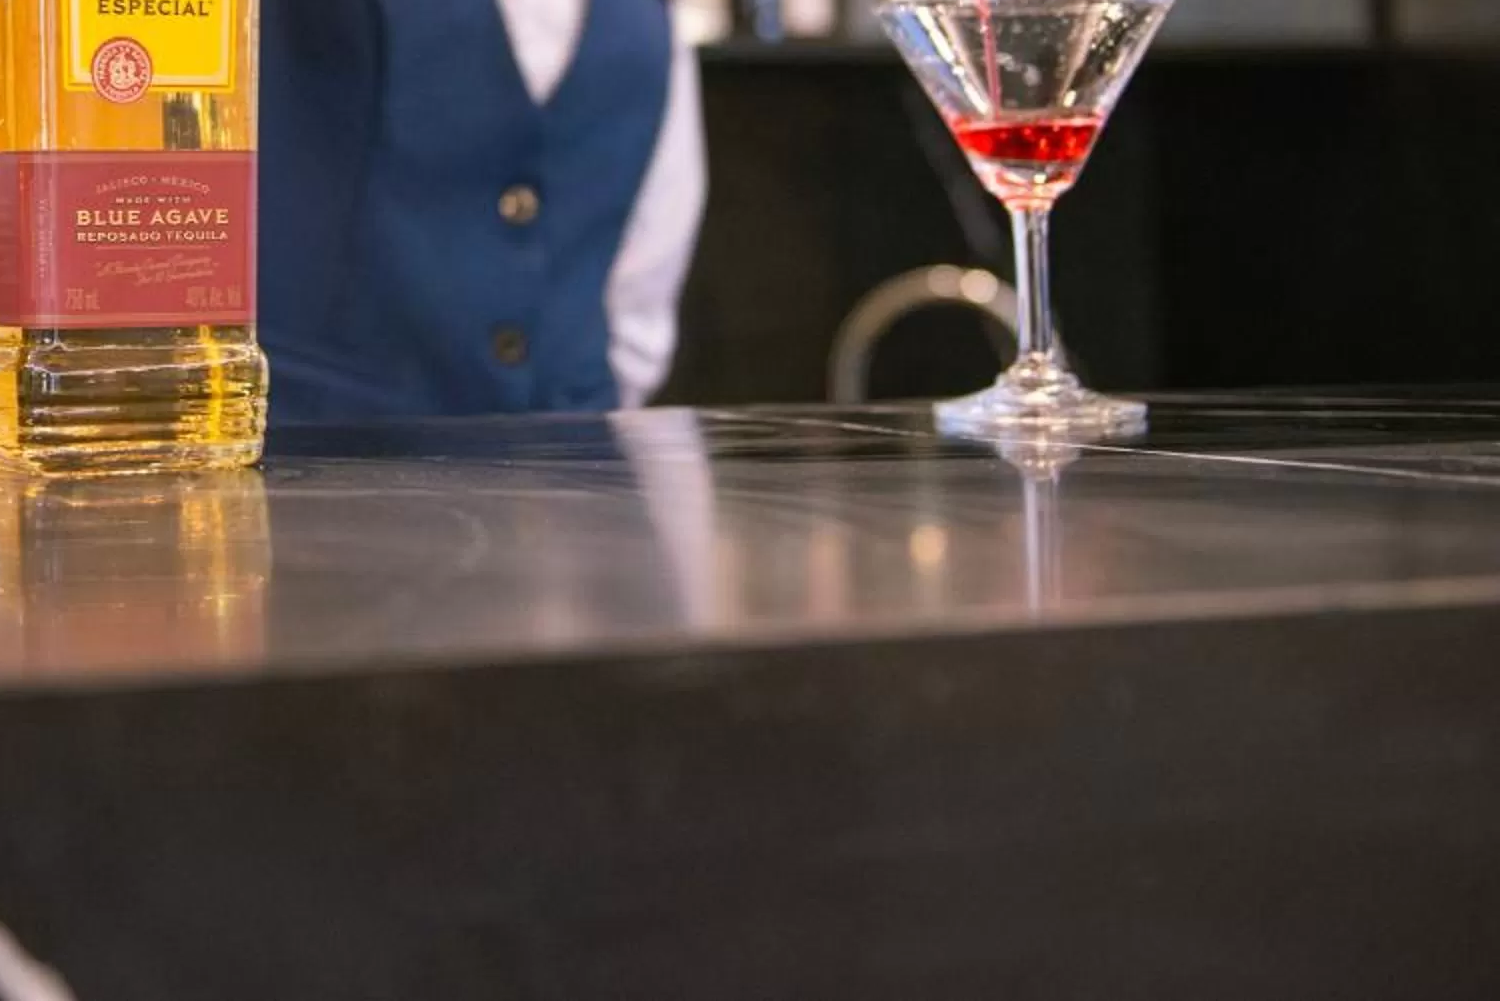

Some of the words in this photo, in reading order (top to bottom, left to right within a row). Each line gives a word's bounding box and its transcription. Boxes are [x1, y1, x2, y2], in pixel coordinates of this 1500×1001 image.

[76, 210, 142, 226] BLUE
[150, 208, 229, 225] AGAVE
[77, 230, 161, 242] REPOSADO
[166, 229, 228, 241] TEQUILA
